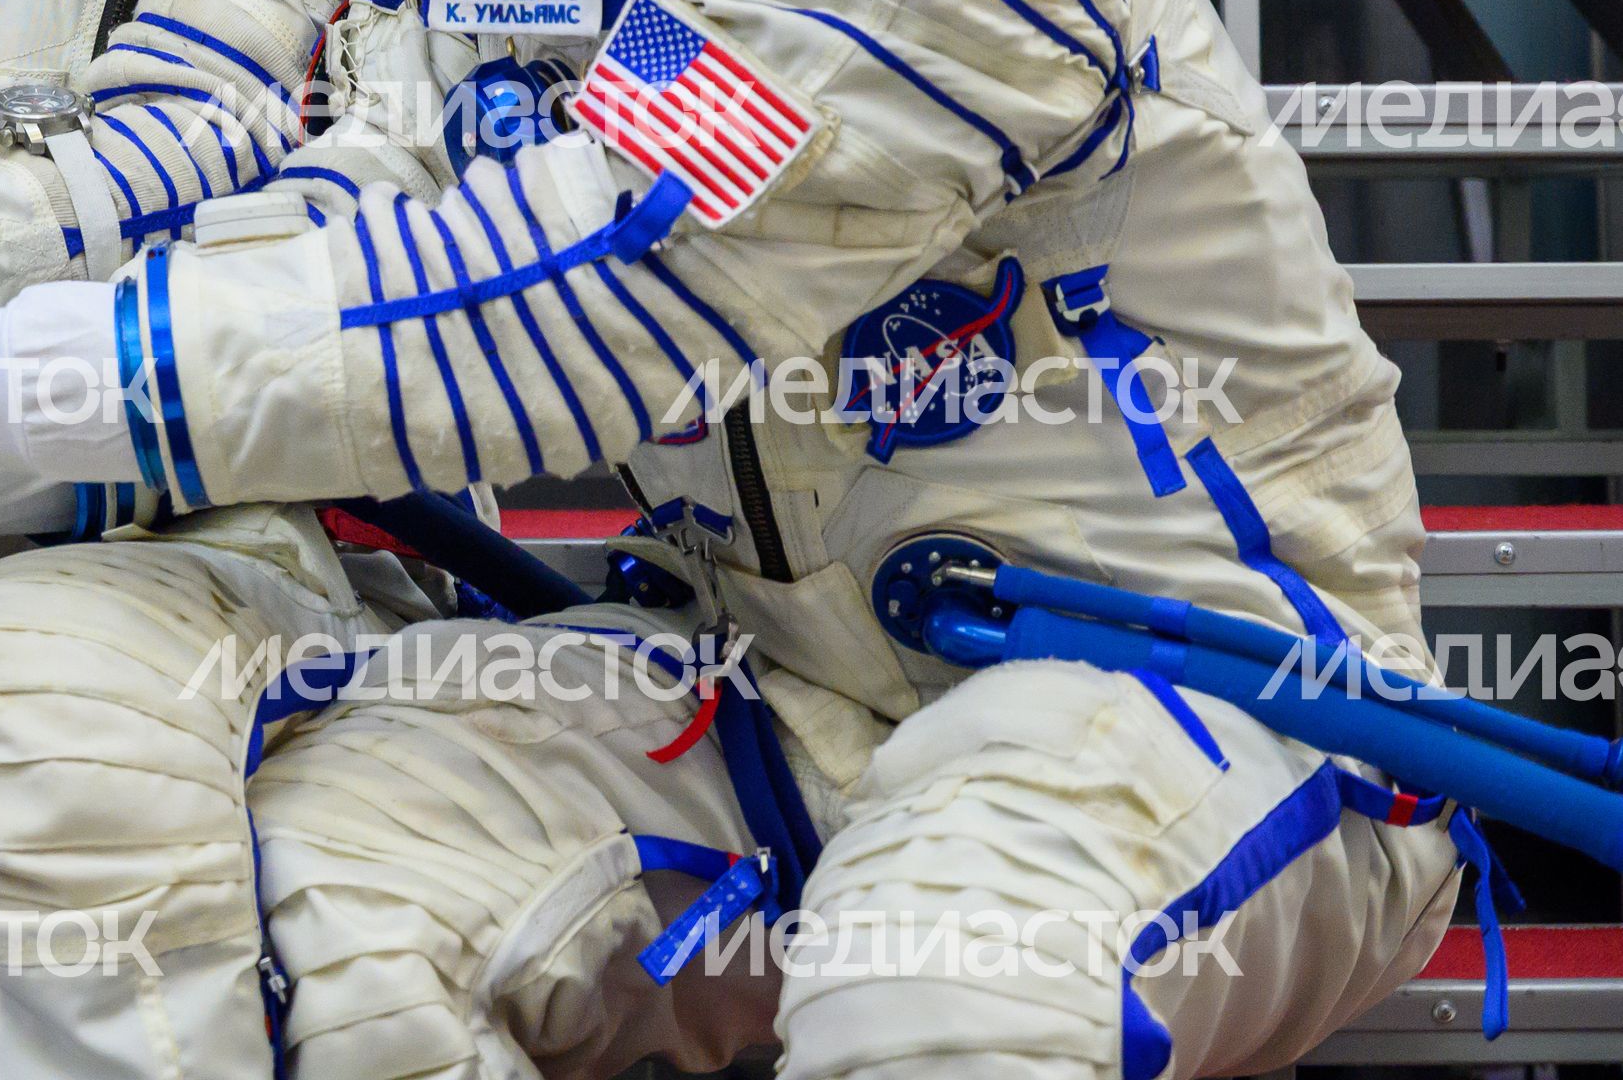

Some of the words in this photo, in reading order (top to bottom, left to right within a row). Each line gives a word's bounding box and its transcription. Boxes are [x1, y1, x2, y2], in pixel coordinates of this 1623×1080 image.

[446, 2, 467, 23] К.
[474, 3, 581, 25] УИЛЬЯМС
[864, 332, 1000, 391] NASA
